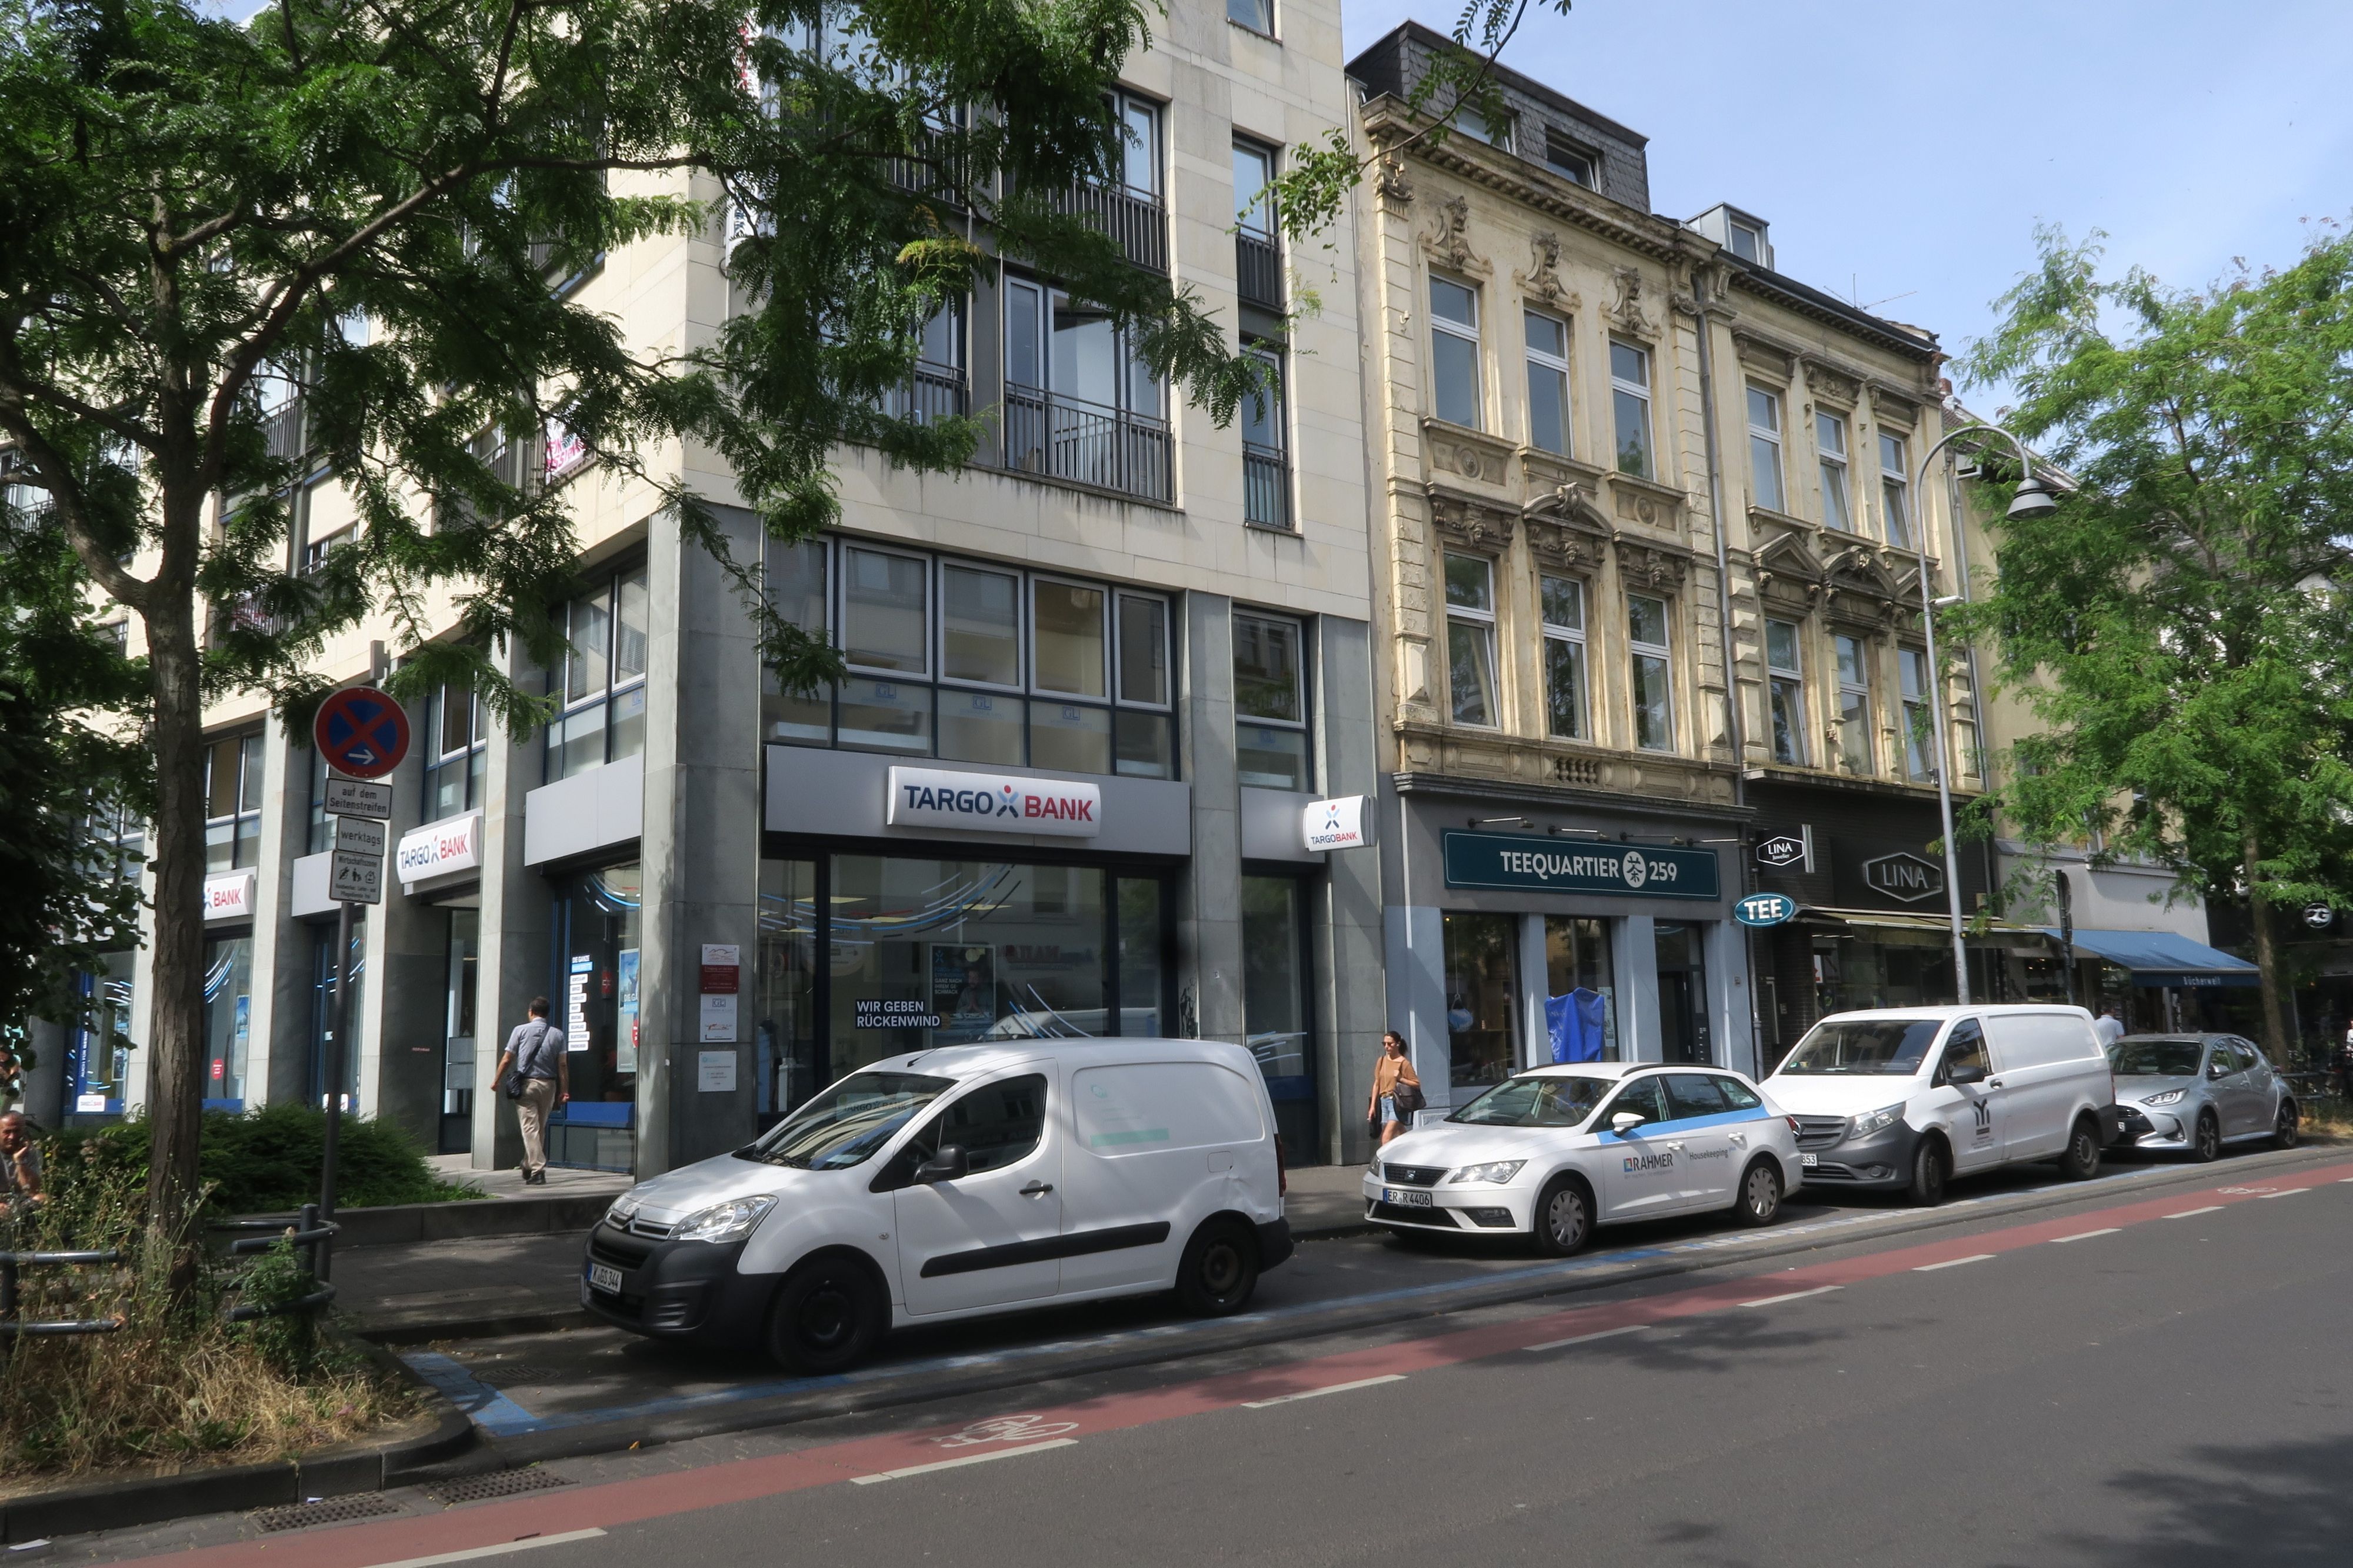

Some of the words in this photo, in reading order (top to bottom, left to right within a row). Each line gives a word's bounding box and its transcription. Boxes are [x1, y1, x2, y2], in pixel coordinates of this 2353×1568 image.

[342, 787, 356, 797] auf
[360, 789, 377, 800] dem
[329, 797, 387, 813] Seitenstreifen
[903, 785, 994, 815] TARGO
[1024, 795, 1093, 822] BANK
[340, 829, 382, 847] werktags
[1310, 832, 1358, 845] TARGOBANK
[400, 845, 430, 870] TARGO
[440, 832, 468, 859] BANK
[1768, 842, 1793, 855] LINA
[1499, 851, 1619, 880] TEEQUARTIER
[1649, 861, 1677, 881] 259
[1882, 863, 1929, 889] LINA
[214, 888, 242, 908] BANK
[1744, 899, 1783, 920] TEE
[856, 1001, 881, 1012] WIR
[884, 1001, 924, 1012] GEBEN
[856, 1013, 941, 1027] RÜCKENWIND
[1689, 1148, 1729, 1160] Housekeeping
[1801, 1155, 1816, 1165] 853
[1633, 1153, 1674, 1172] RAHMER
[1388, 1191, 1398, 1202] ER
[1403, 1193, 1408, 1203] R
[1409, 1193, 1430, 1206] 4406
